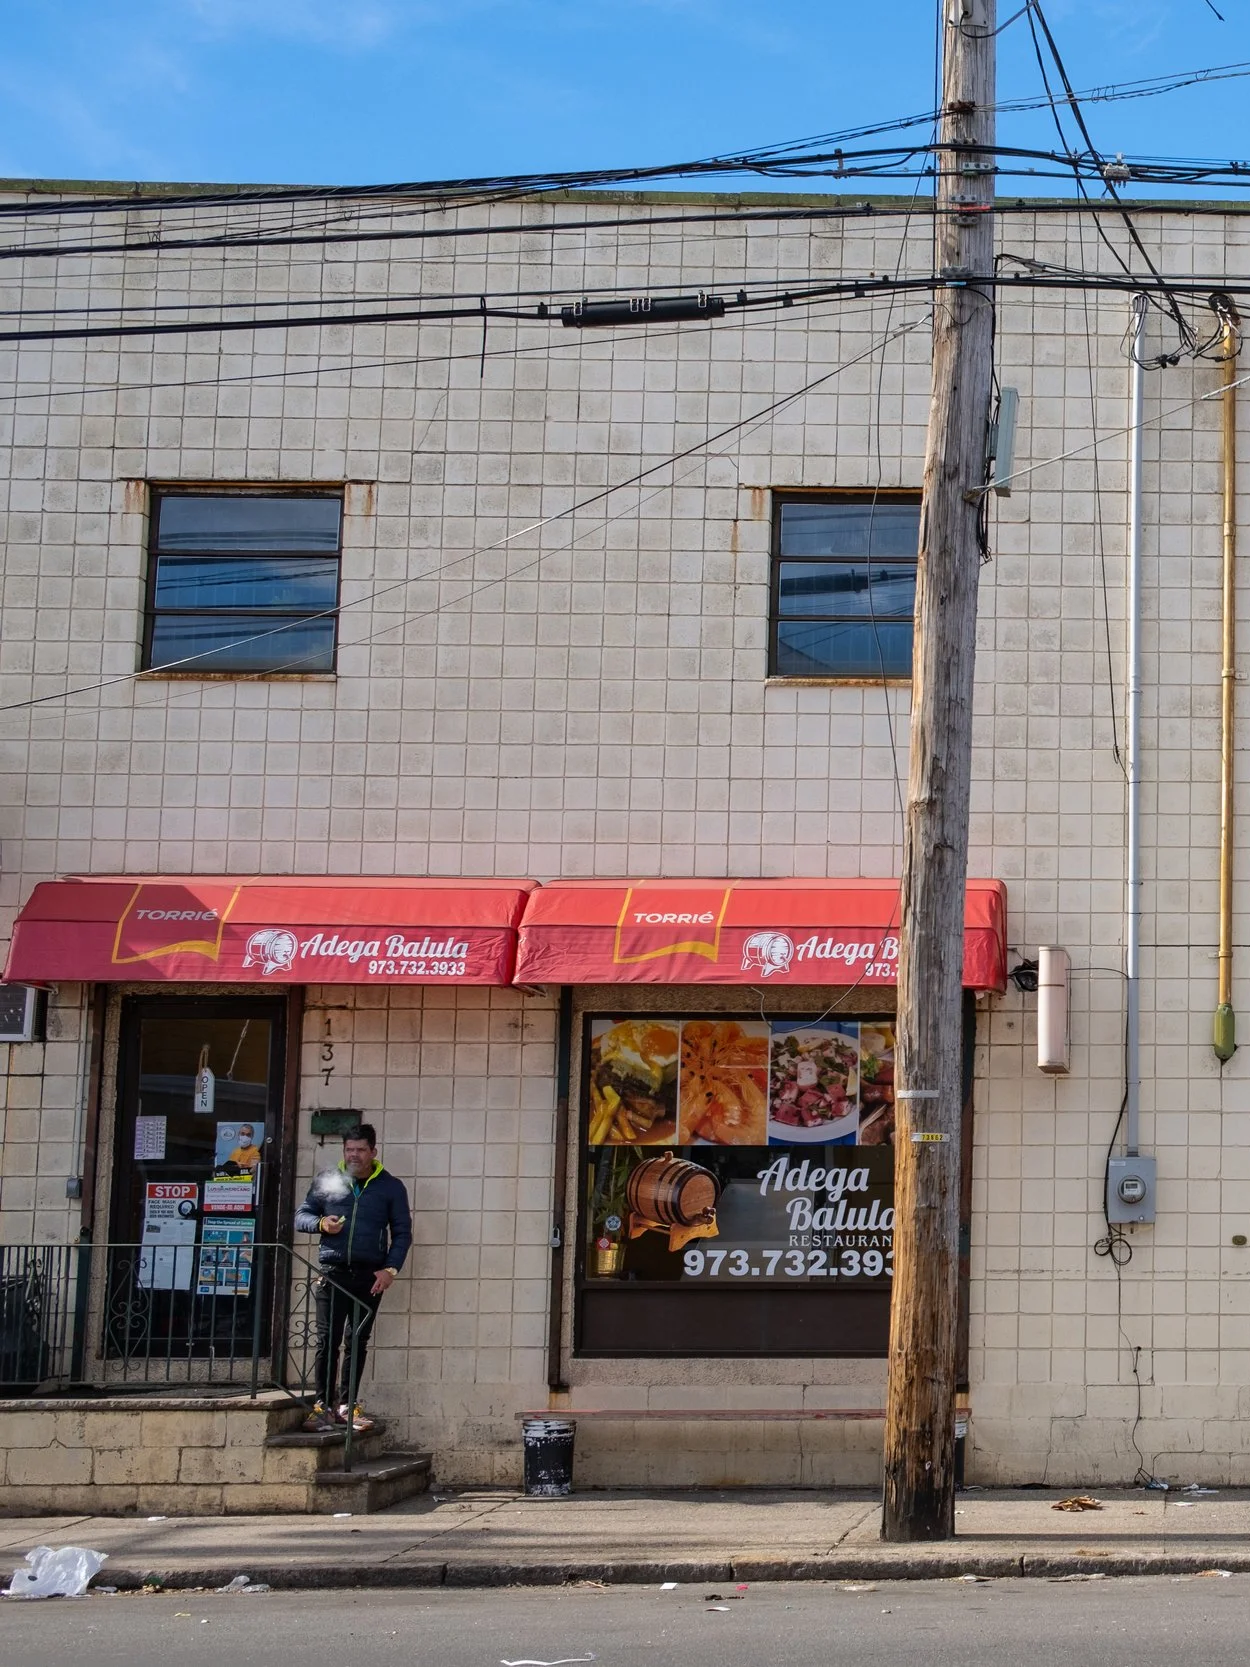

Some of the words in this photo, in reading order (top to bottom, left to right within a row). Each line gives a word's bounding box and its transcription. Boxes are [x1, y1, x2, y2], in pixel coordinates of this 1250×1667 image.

[300, 933, 381, 963] Adega
[385, 934, 469, 959] Balula
[796, 935, 876, 965] Adega
[368, 960, 466, 976] 973.732.3933
[200, 1076, 209, 1107] OPEN
[155, 1185, 191, 1197] STOP
[757, 1157, 870, 1203] Adega
[788, 1234, 892, 1247] RESTAURAN
[683, 1250, 894, 1277] 973.732.39
